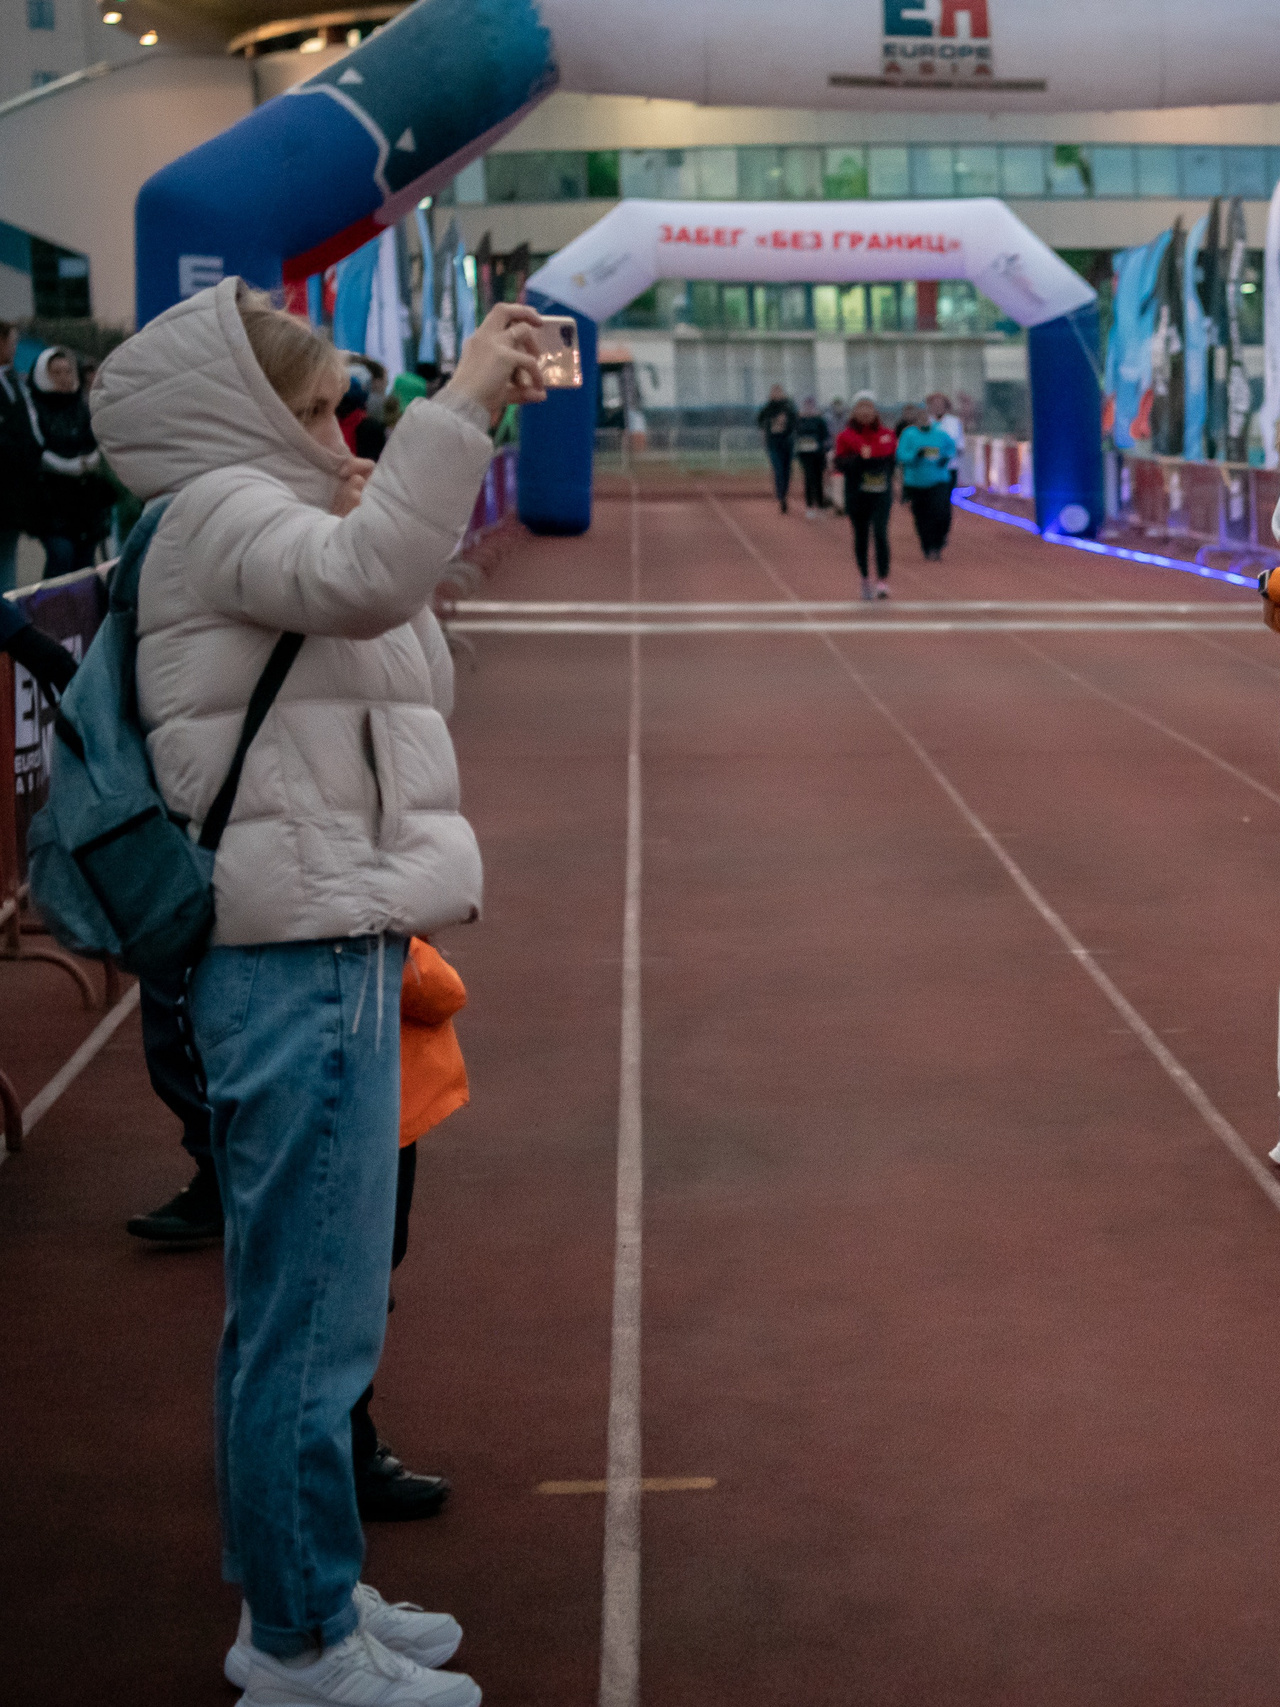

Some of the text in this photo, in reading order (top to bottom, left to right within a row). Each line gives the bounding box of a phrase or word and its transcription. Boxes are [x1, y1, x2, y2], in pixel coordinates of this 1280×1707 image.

[884, 43, 991, 59] EUROPE
[885, 61, 991, 76] ASIA
[660, 224, 961, 254] ЗАБЕГ «БЕЗ ГРАНИЦ»
